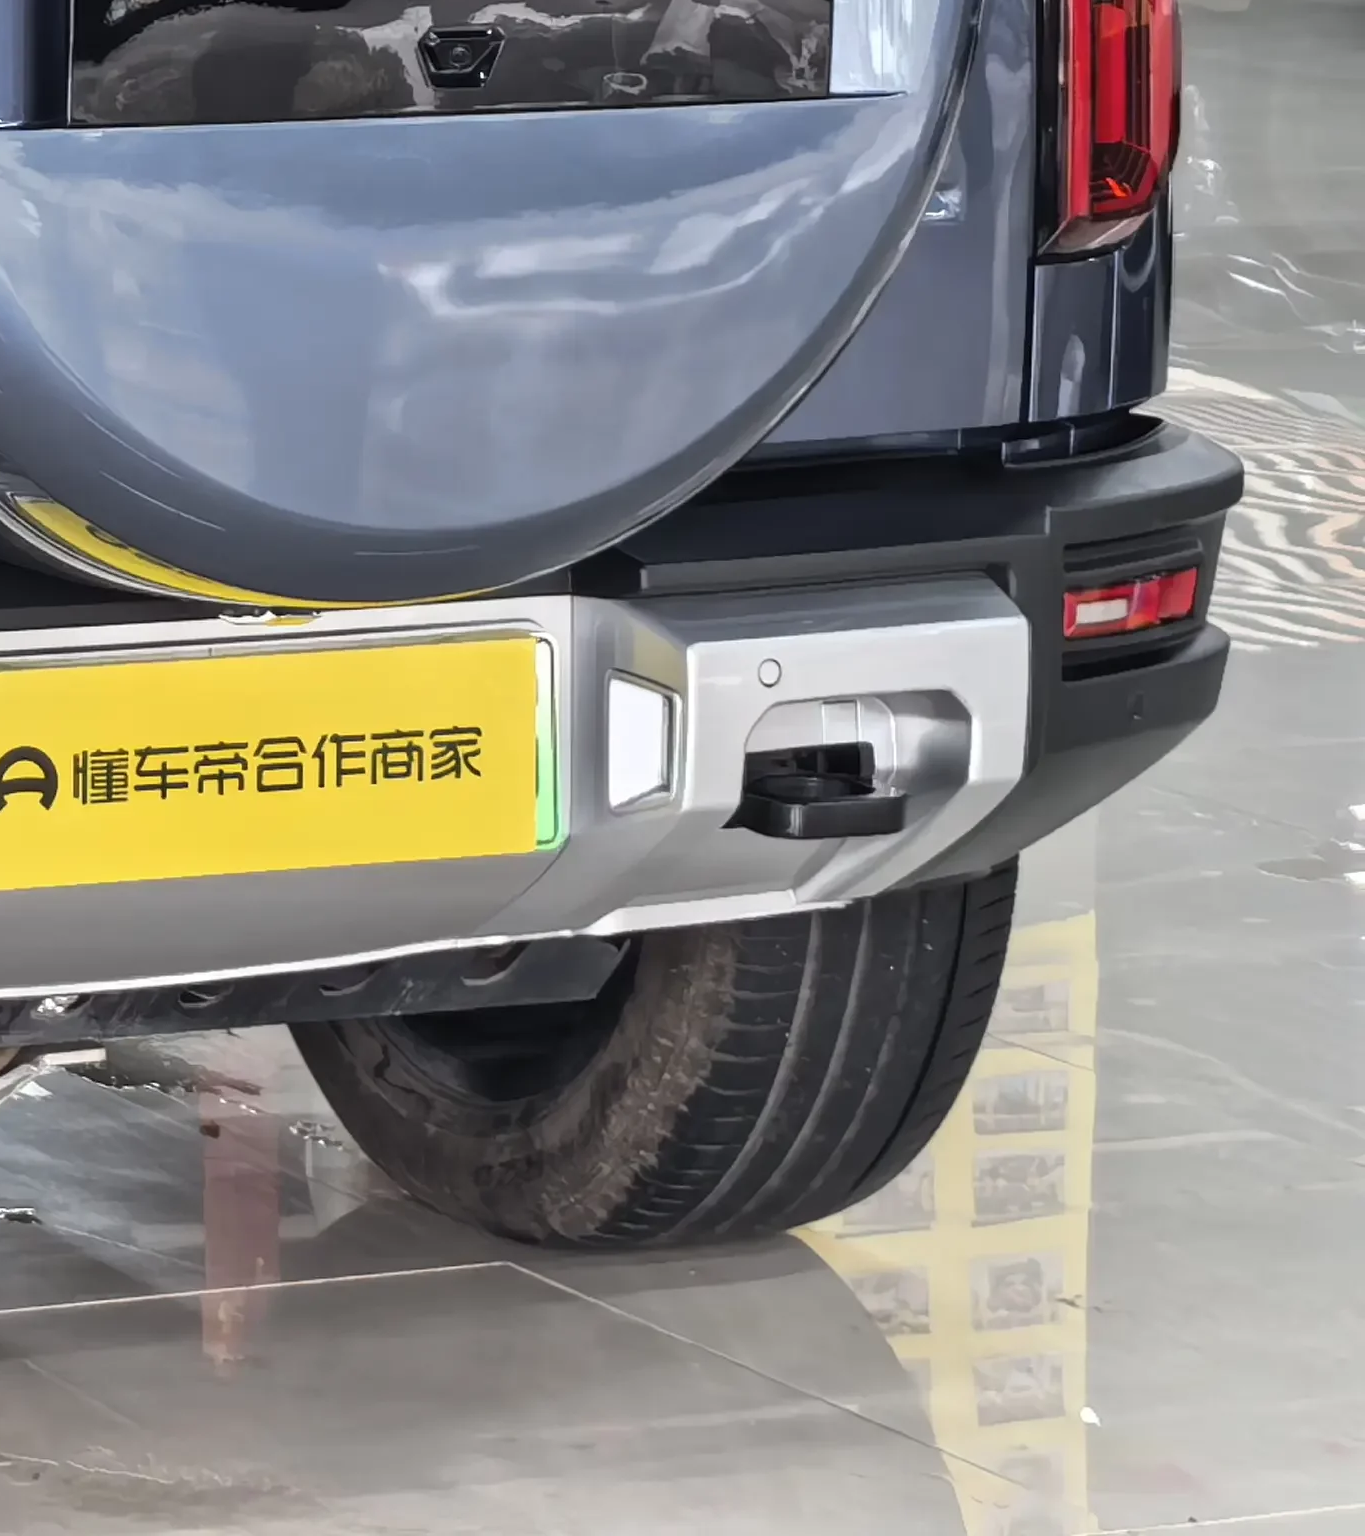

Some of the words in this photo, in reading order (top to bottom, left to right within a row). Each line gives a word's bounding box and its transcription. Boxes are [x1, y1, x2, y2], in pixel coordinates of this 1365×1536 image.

[72, 725, 483, 805] 懂车帝合作商家
